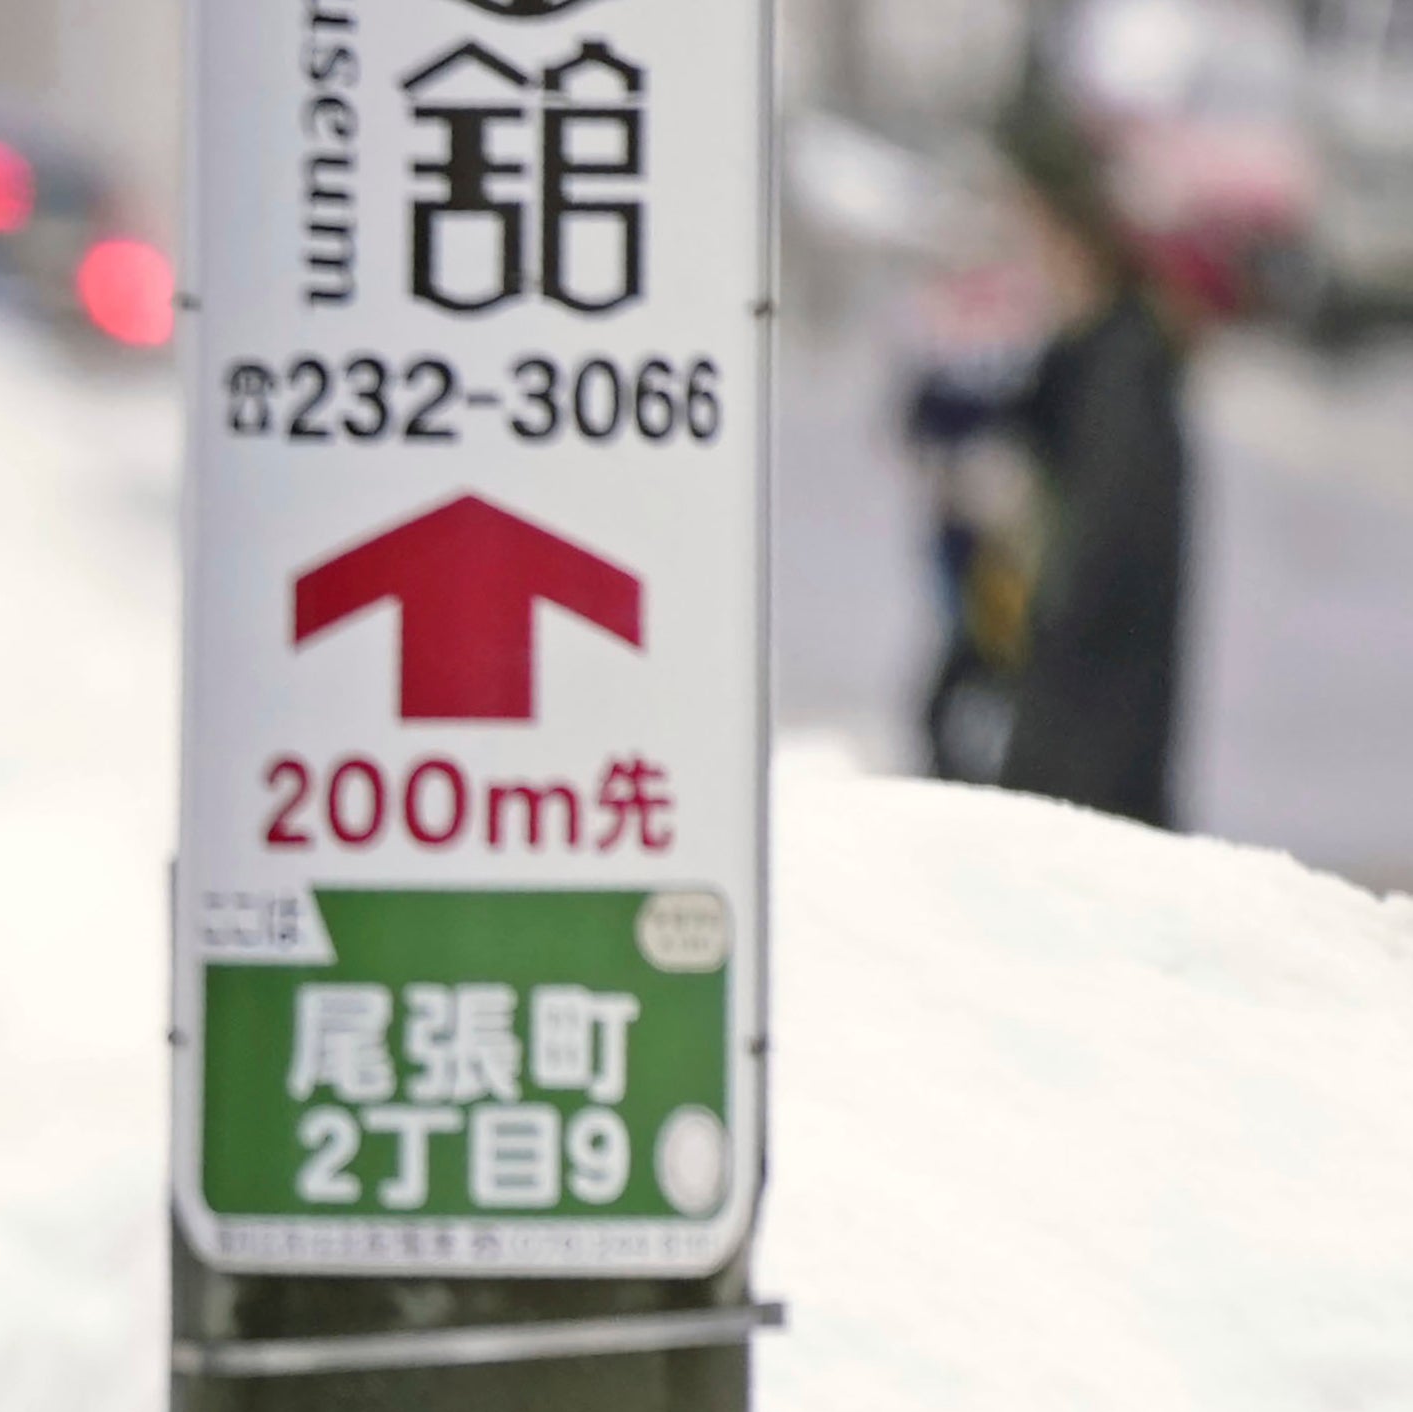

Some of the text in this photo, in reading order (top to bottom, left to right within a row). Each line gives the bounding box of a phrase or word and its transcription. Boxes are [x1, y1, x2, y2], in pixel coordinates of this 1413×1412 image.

[285, 355, 720, 441] 232-3066
[264, 756, 672, 851] 200m先
[289, 982, 639, 1103] 尾張町
[295, 1106, 631, 1208] 2丁目9
